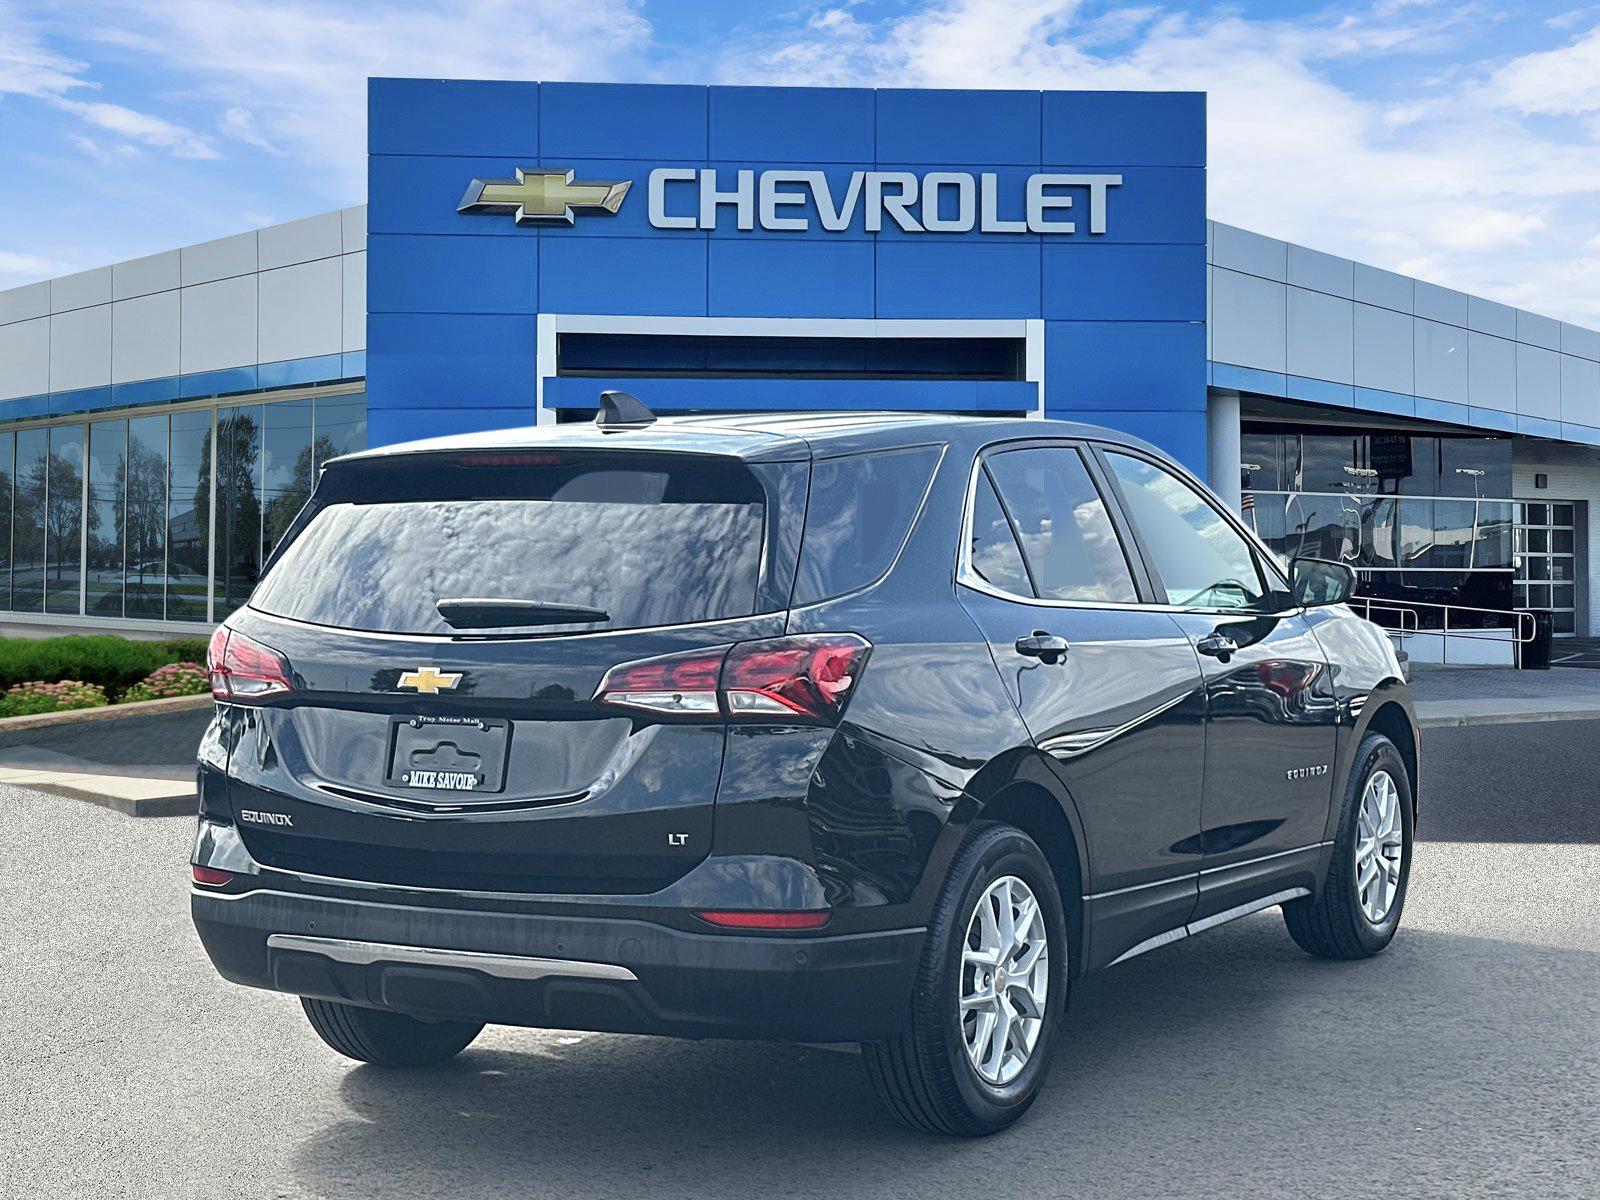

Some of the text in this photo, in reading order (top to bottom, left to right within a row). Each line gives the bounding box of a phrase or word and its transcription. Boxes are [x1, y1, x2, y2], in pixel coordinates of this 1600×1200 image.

[648, 167, 1123, 235] CHEVROLET
[418, 715, 436, 723] Troy
[409, 770, 475, 790] MIKE SAVOIE
[1286, 764, 1328, 780] EQUINOX
[241, 809, 294, 827] EQUINOX
[668, 833, 689, 845] LT
